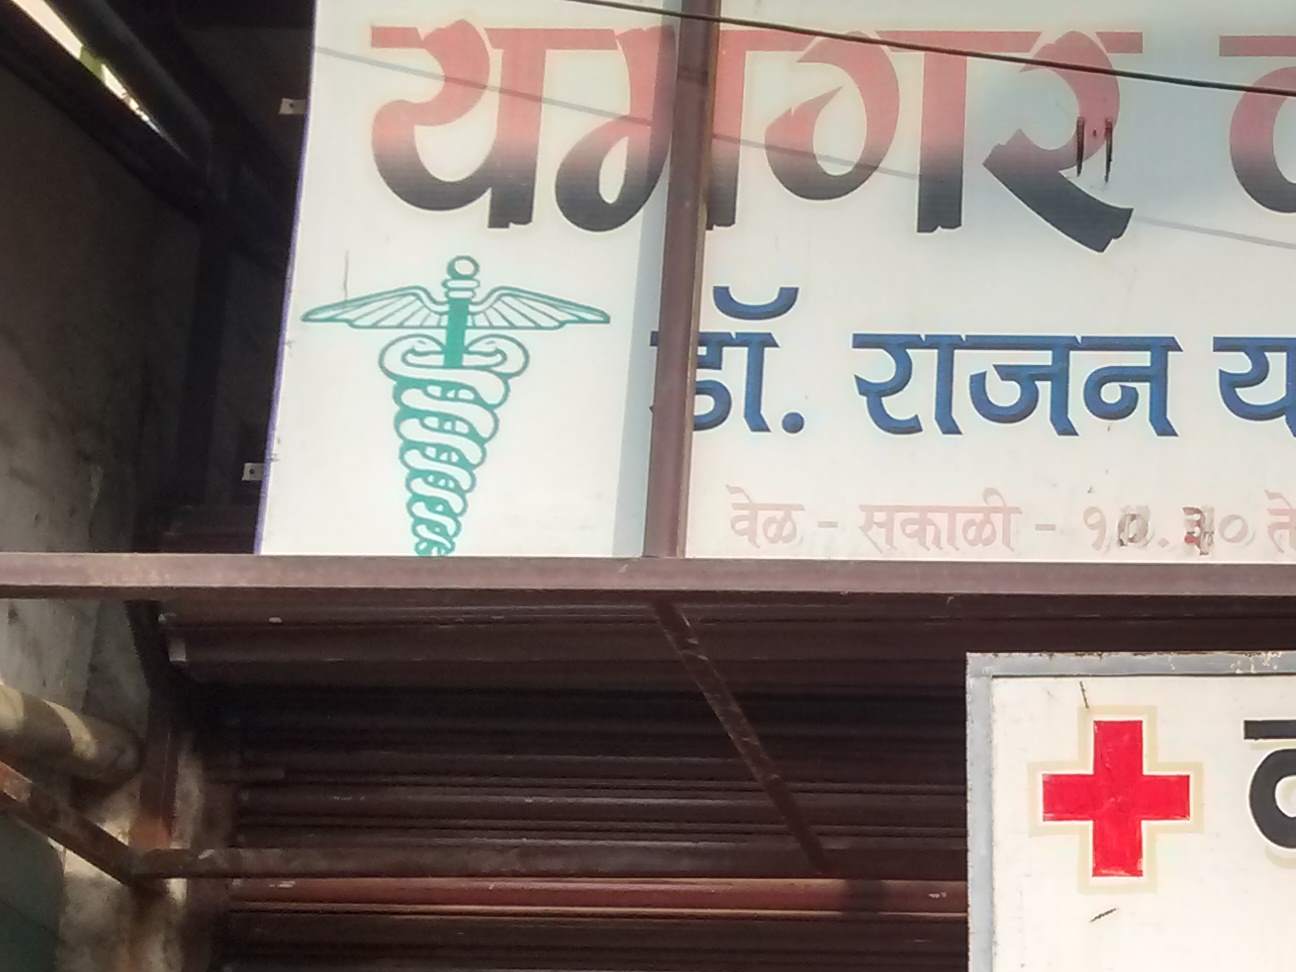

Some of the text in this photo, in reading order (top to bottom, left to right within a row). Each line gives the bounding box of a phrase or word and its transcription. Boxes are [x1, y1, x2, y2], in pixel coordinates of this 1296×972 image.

[371, 19, 1142, 253] यमगर
[852, 334, 1182, 436] राजन
[725, 484, 805, 549] वेळ
[858, 487, 1023, 553] सकाळी
